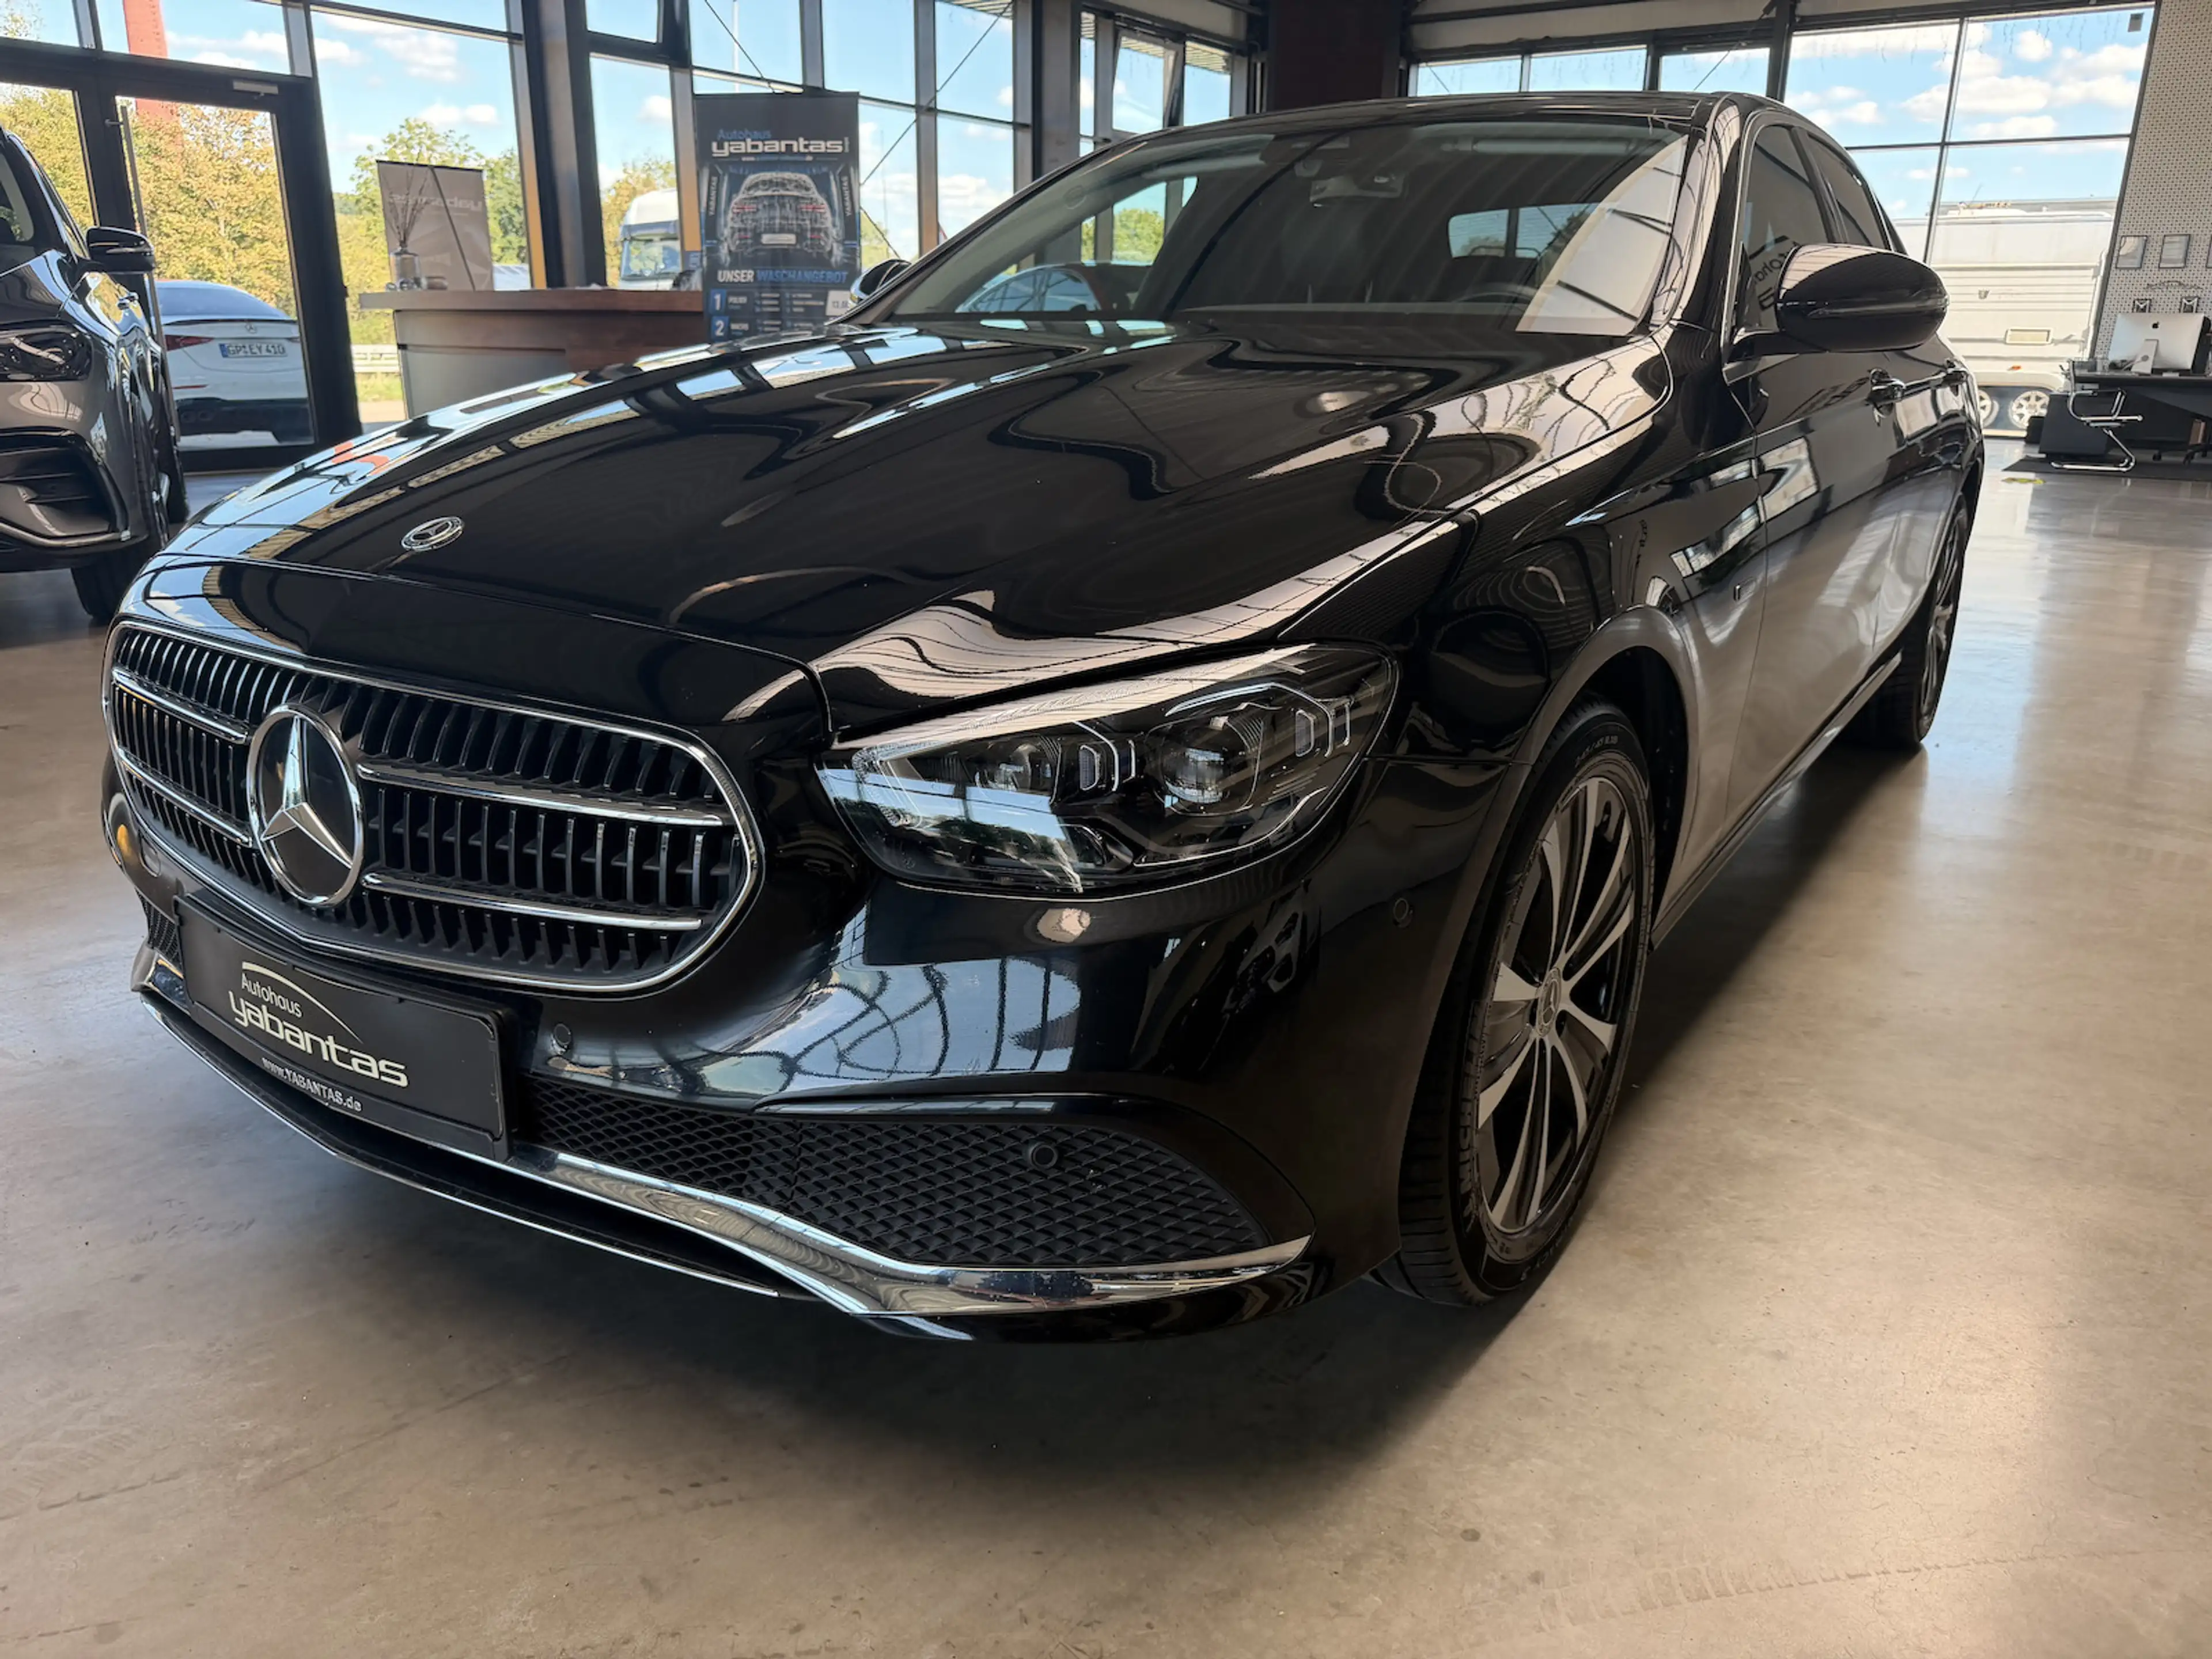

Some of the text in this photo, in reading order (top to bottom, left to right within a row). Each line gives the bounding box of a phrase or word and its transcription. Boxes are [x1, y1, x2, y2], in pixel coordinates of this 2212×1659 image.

[718, 128, 771, 140] Autohaus
[711, 137, 843, 157] yabantas
[717, 270, 848, 283] UNSER WASCHANGEBOT
[714, 294, 721, 310] 1
[715, 321, 724, 336] 2
[241, 972, 302, 1018] Autohaus
[229, 991, 408, 1087] yabantas
[262, 1058, 362, 1112] www.YABANTAS.de
